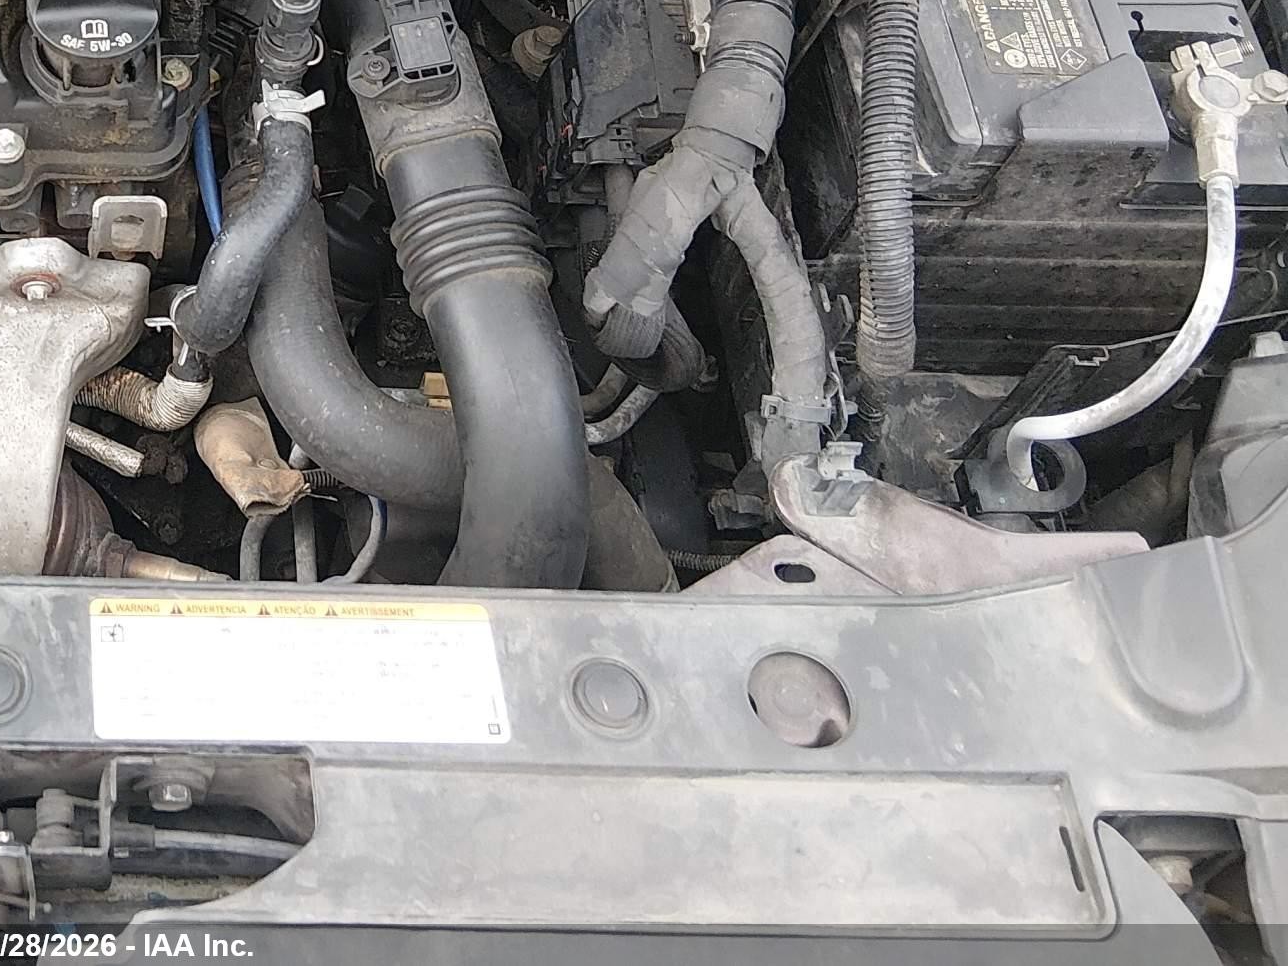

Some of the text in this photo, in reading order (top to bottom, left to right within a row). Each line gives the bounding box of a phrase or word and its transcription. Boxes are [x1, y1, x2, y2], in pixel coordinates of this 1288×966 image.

[89, 32, 133, 52] 5W-30
[115, 603, 415, 618] WARNING ADVERTENCIA ATENÇÃO AVERTISSEMENT
